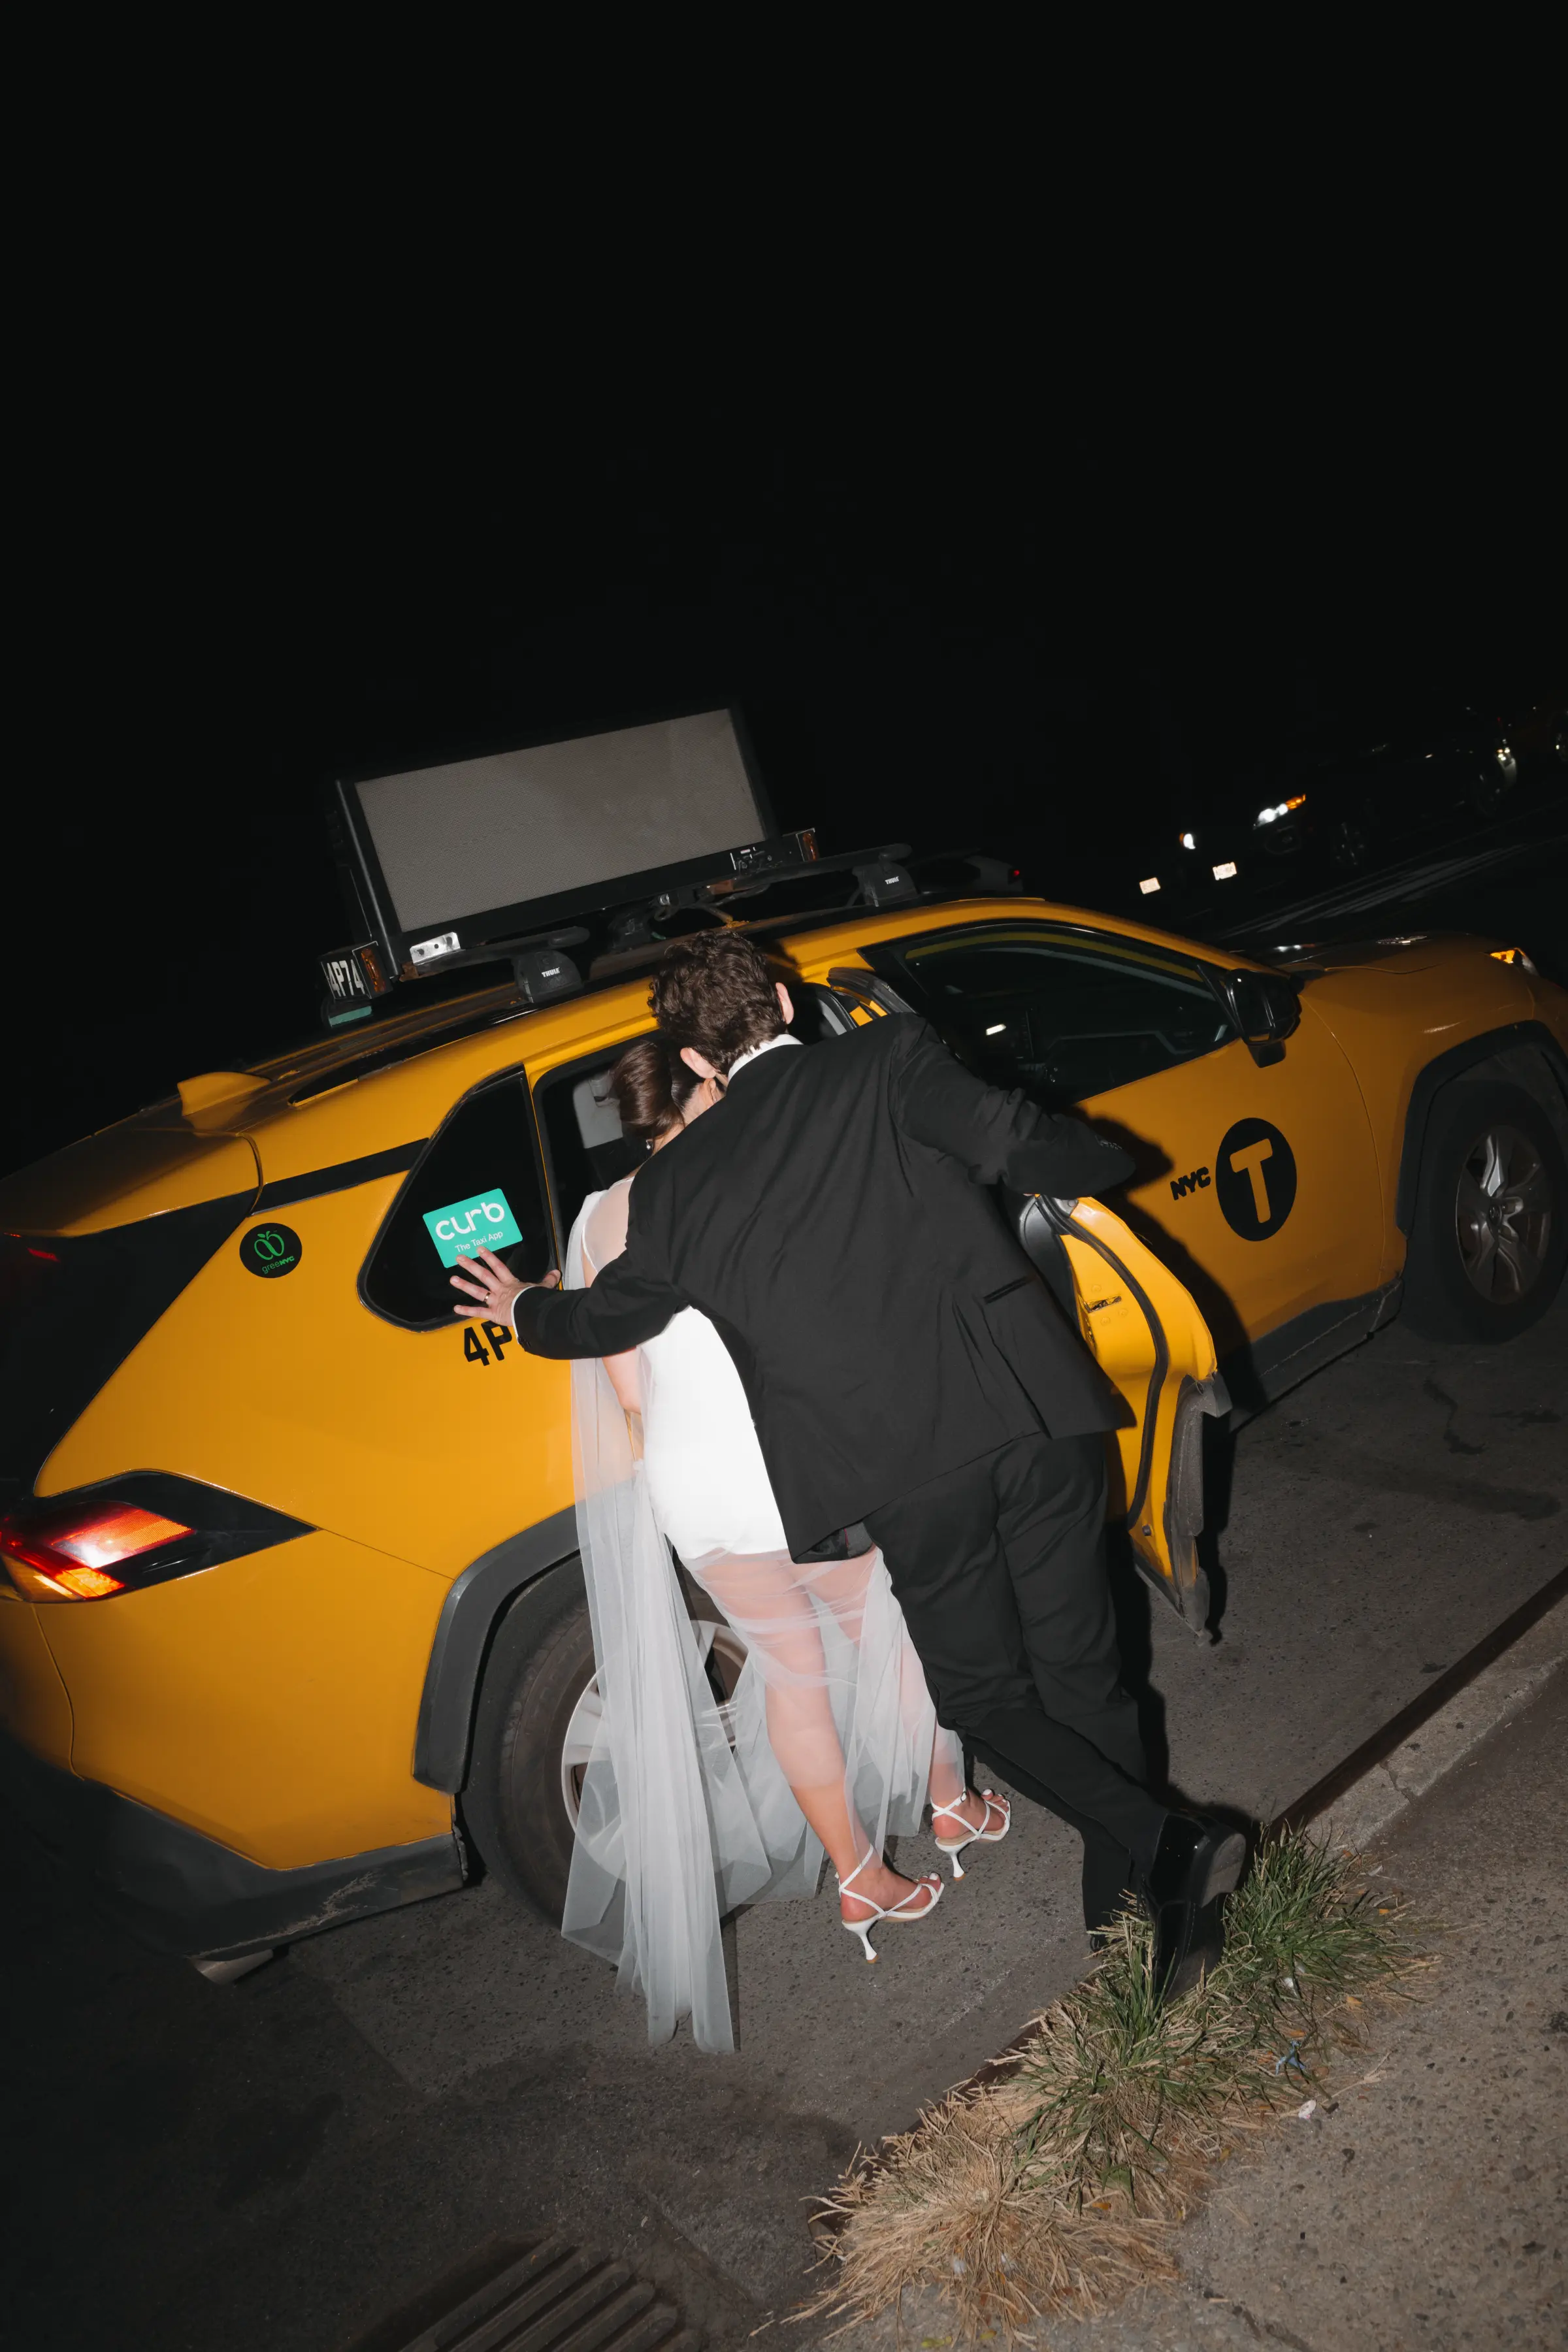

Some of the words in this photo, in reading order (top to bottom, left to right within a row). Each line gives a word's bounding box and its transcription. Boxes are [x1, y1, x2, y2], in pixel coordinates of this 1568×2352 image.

[885, 876, 900, 885] THULE
[327, 959, 365, 997] 4P74
[542, 967, 561, 977] THULE
[1169, 1166, 1211, 1201] NYC
[1230, 1138, 1273, 1224] T
[435, 1201, 505, 1240] curb
[455, 1242, 471, 1252] The
[470, 1235, 487, 1247] Taxi
[488, 1231, 504, 1242] App
[262, 1256, 295, 1274] greeNYC
[464, 1320, 513, 1367] 4P
